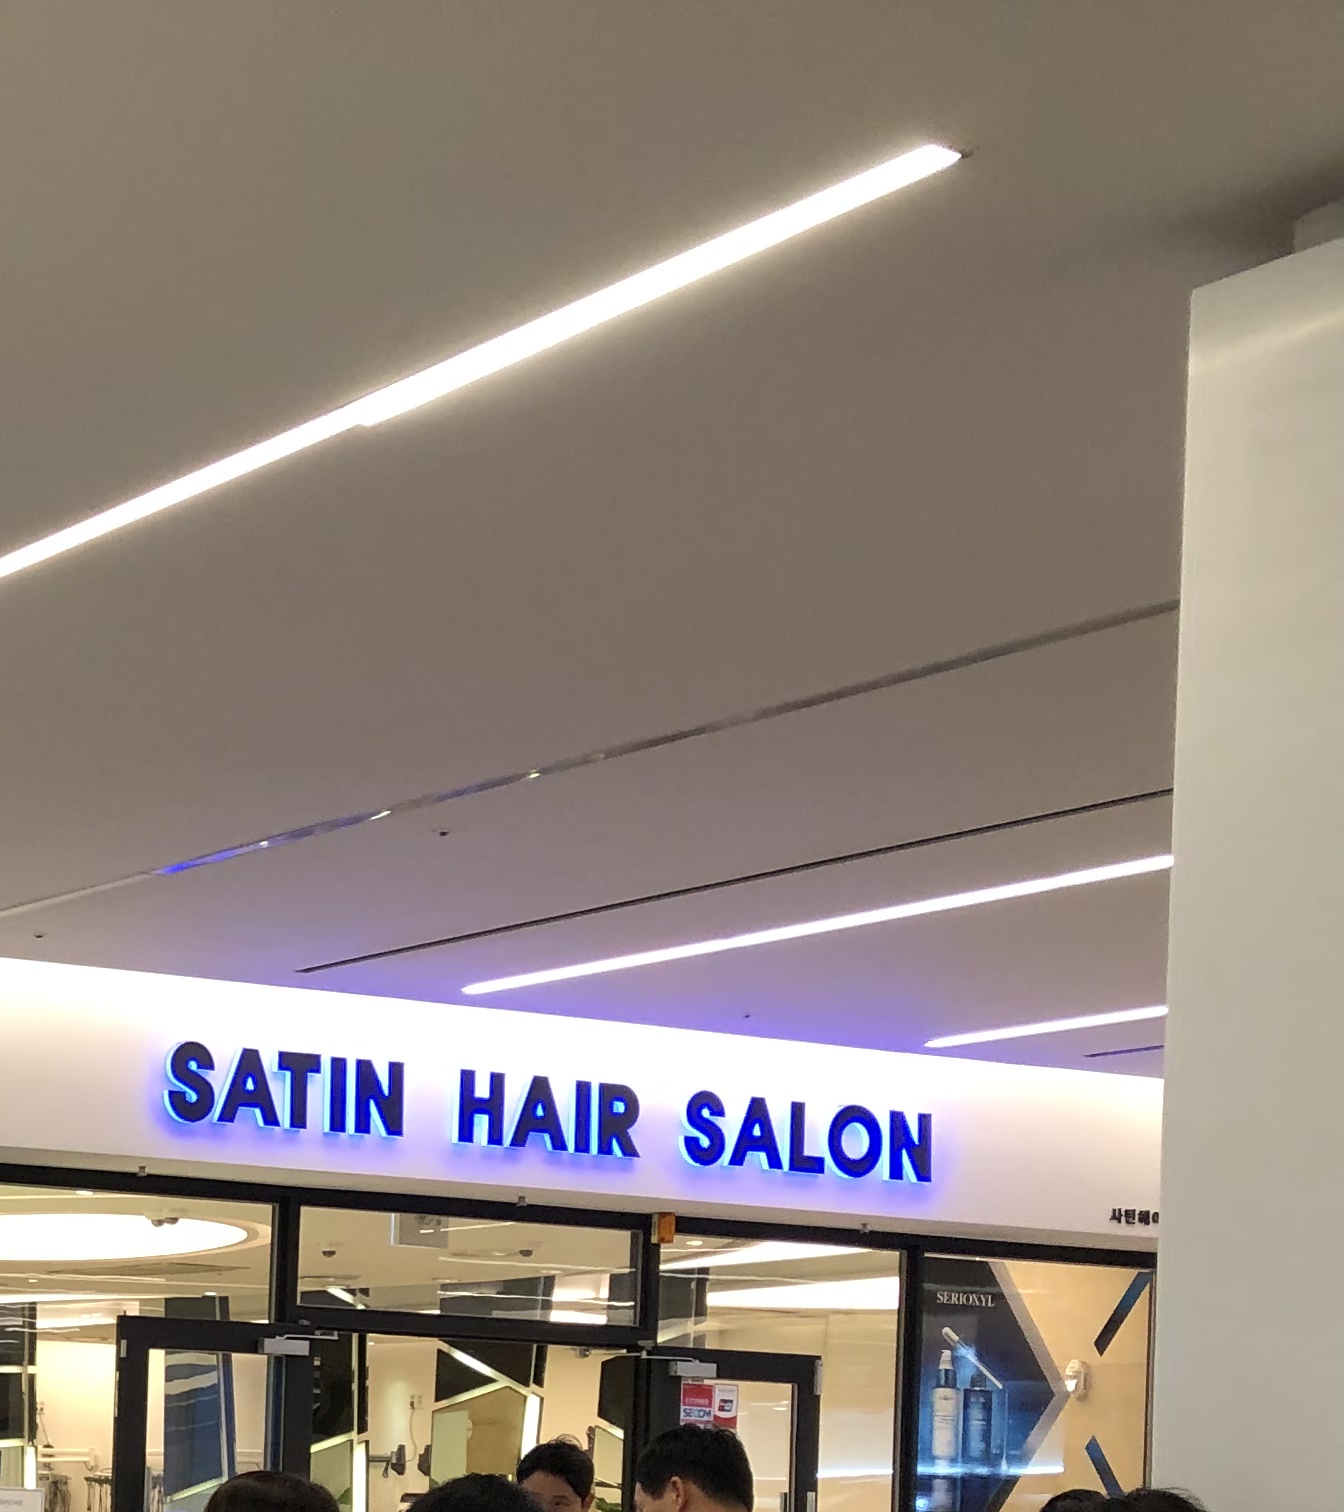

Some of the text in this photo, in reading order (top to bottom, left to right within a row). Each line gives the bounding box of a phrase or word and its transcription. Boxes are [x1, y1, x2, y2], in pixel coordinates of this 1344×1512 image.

[163, 1041, 933, 1184] SATIN HAIR SALON
[936, 1291, 995, 1307] SERIOXYL
[683, 1408, 712, 1418] SECOM
